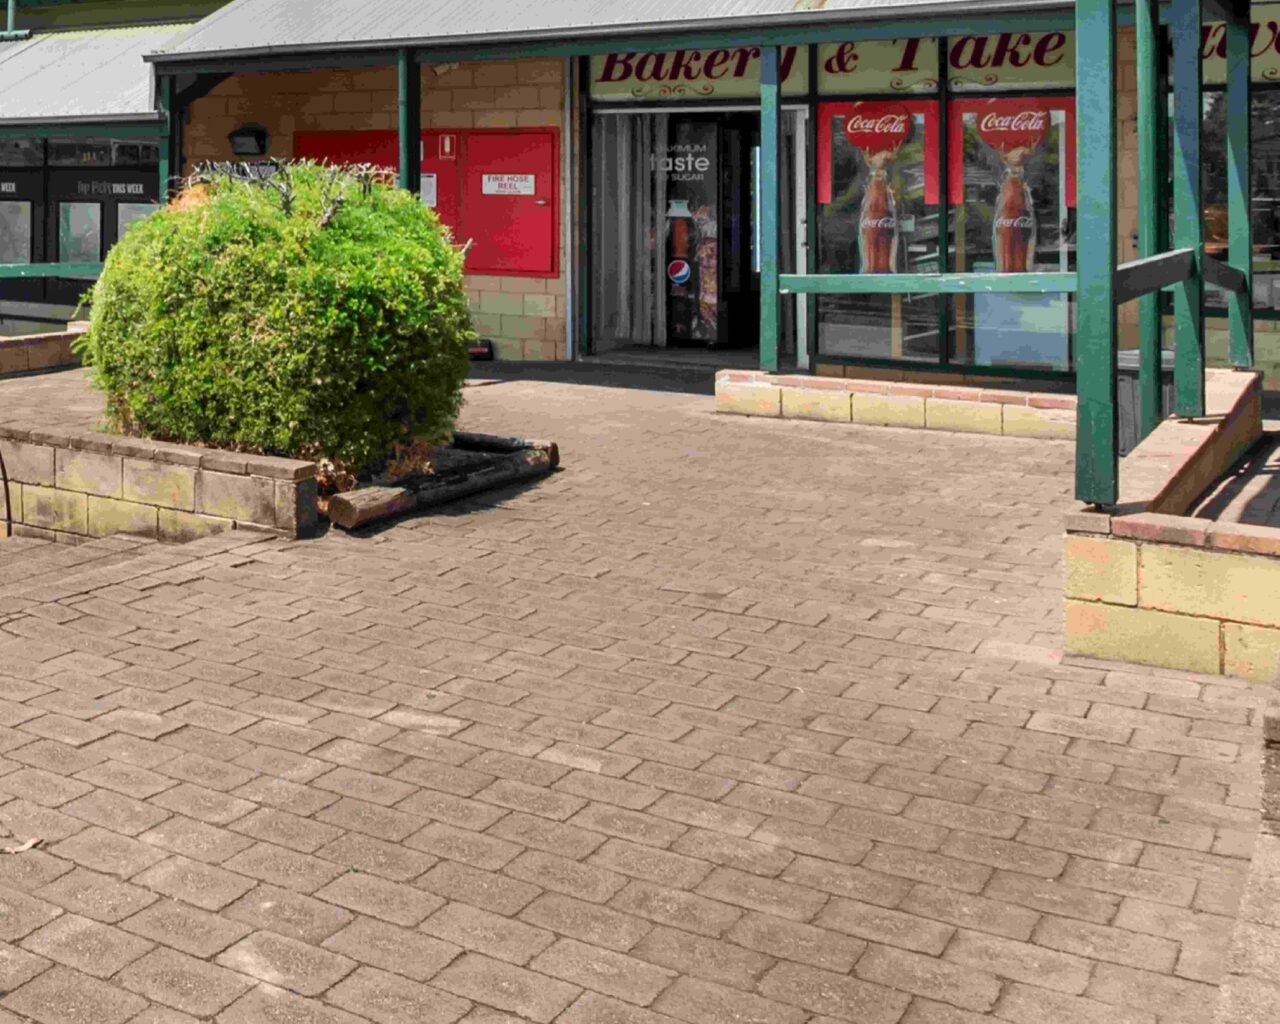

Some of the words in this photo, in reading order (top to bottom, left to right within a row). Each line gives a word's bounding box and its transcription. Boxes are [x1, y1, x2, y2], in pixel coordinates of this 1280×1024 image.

[824, 41, 860, 74] &
[891, 32, 1067, 72] Take
[847, 113, 909, 134] Coca-Cola
[980, 111, 1048, 133] Coca-Cola
[650, 152, 711, 172] taste
[487, 175, 504, 183] FIRE
[506, 175, 529, 183] HOSE
